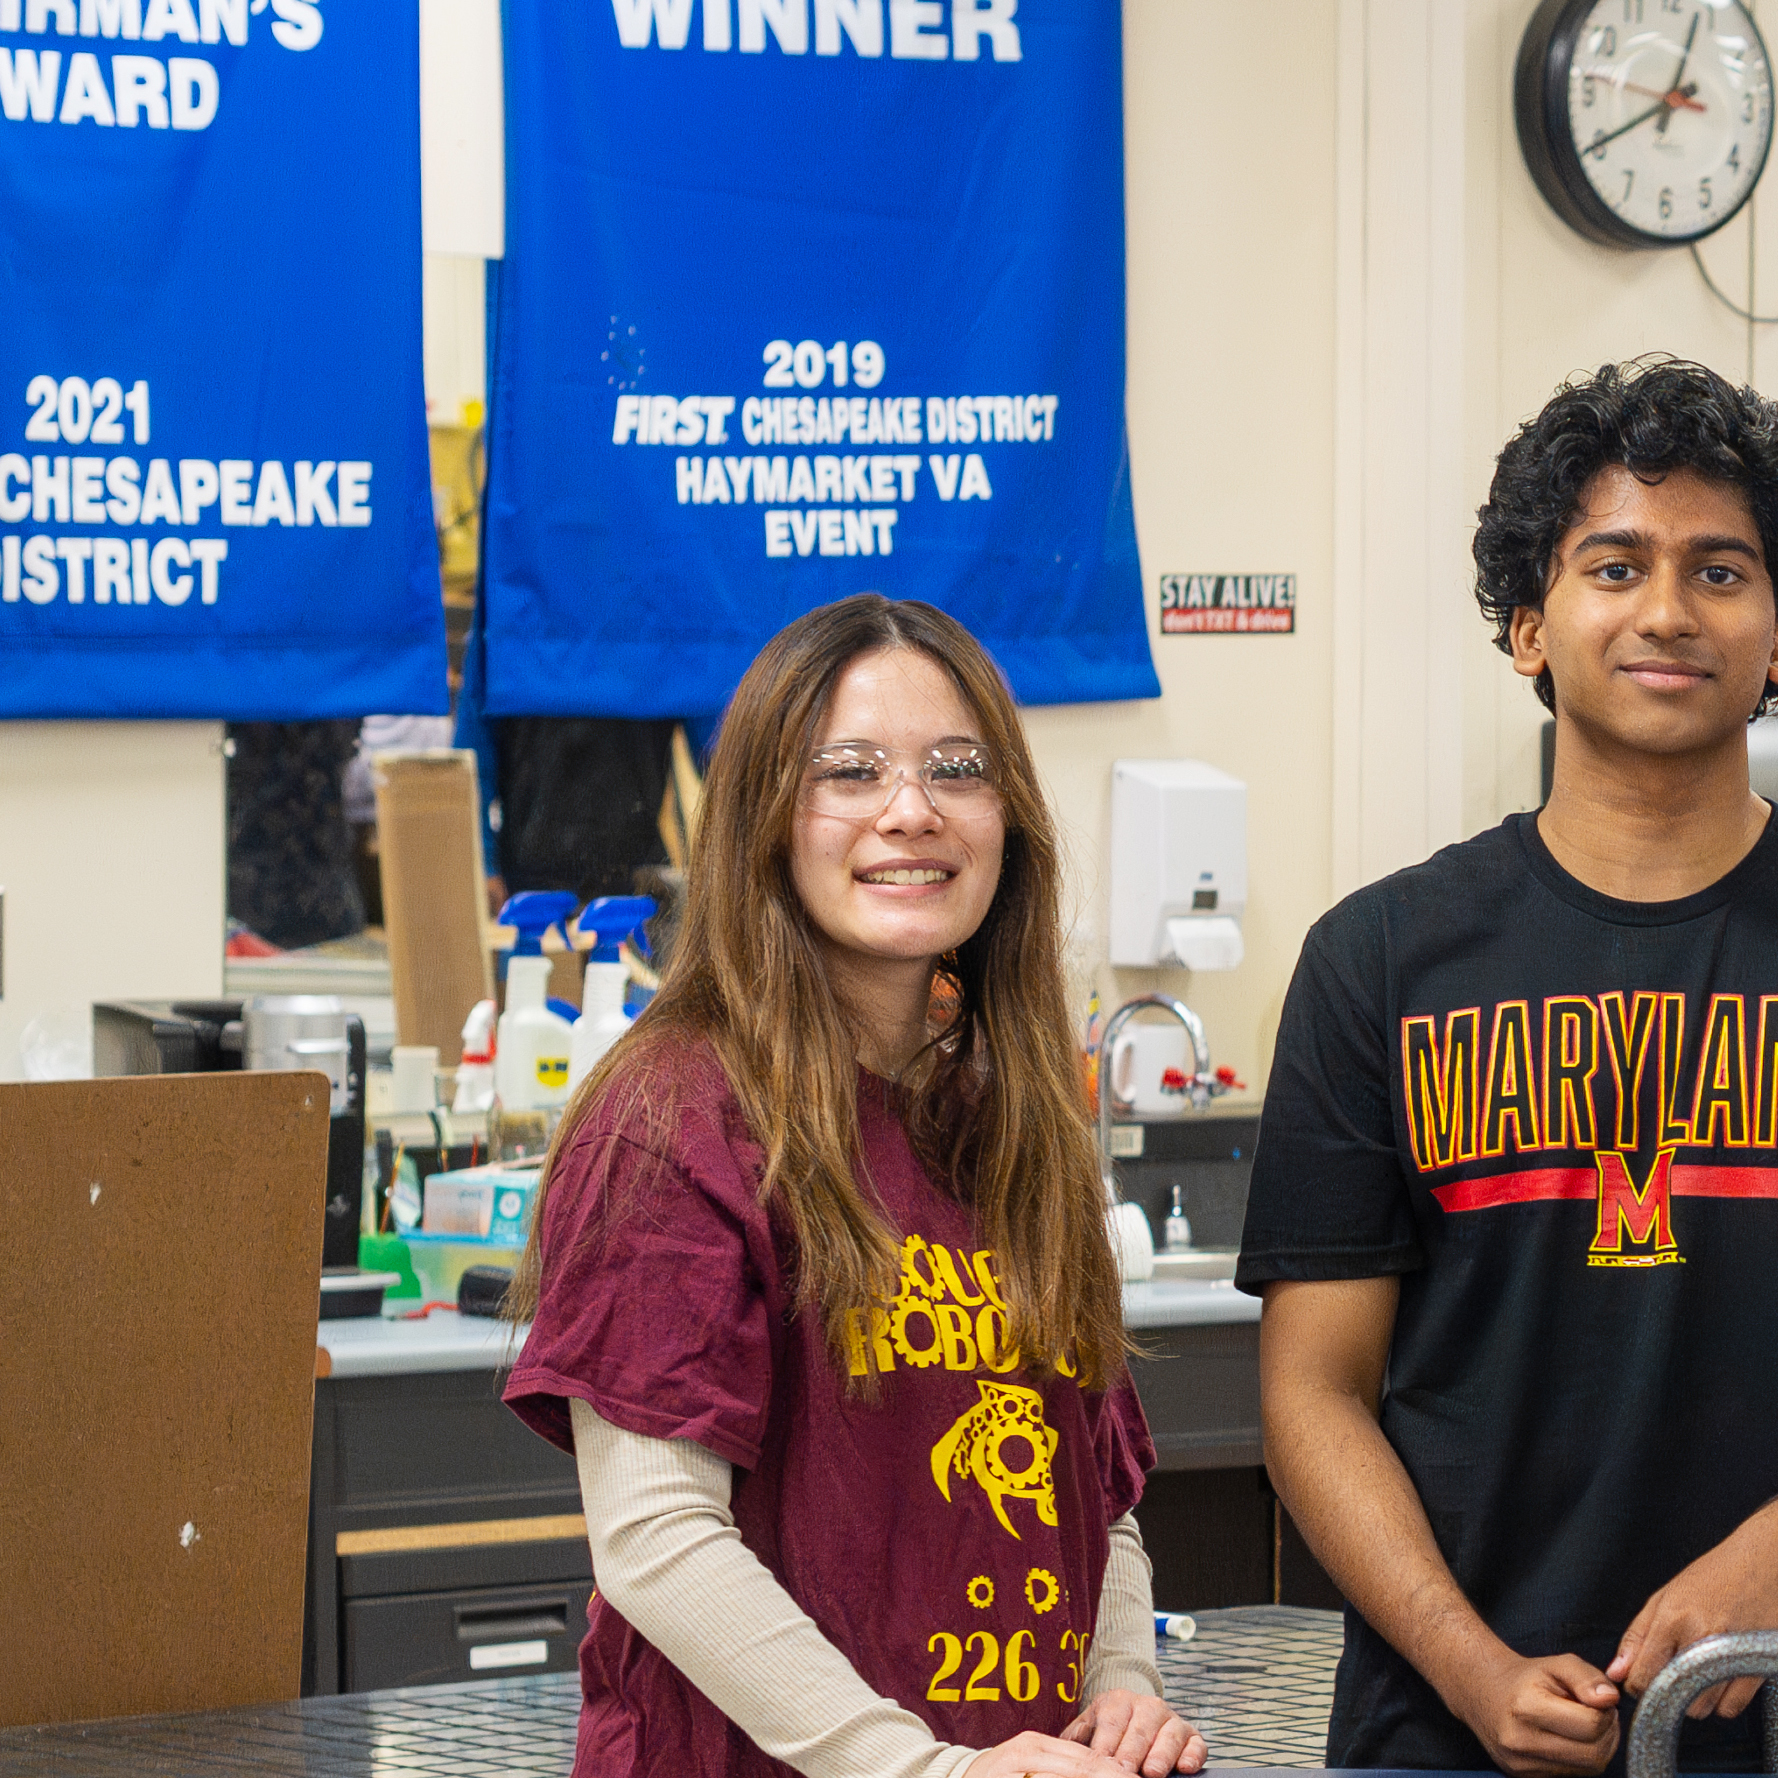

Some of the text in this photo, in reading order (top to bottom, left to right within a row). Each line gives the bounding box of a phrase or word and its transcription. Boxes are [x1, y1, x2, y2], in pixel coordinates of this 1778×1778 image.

[0, 0, 324, 51] IRMAN'S
[613, 0, 1021, 61] WINNER
[0, 50, 220, 132] WARD
[762, 341, 886, 388] 2019
[25, 376, 151, 443] 2021
[612, 394, 1059, 445] FIRST CHESAPEAKE DISTRICT
[0, 453, 373, 527] CHESAPEAKE
[675, 455, 993, 504] HAYMARKET VA
[765, 510, 898, 557] EVENT
[0, 536, 228, 606] ISTRICT
[1161, 574, 1218, 609] STAY
[1589, 1147, 1677, 1252] M
